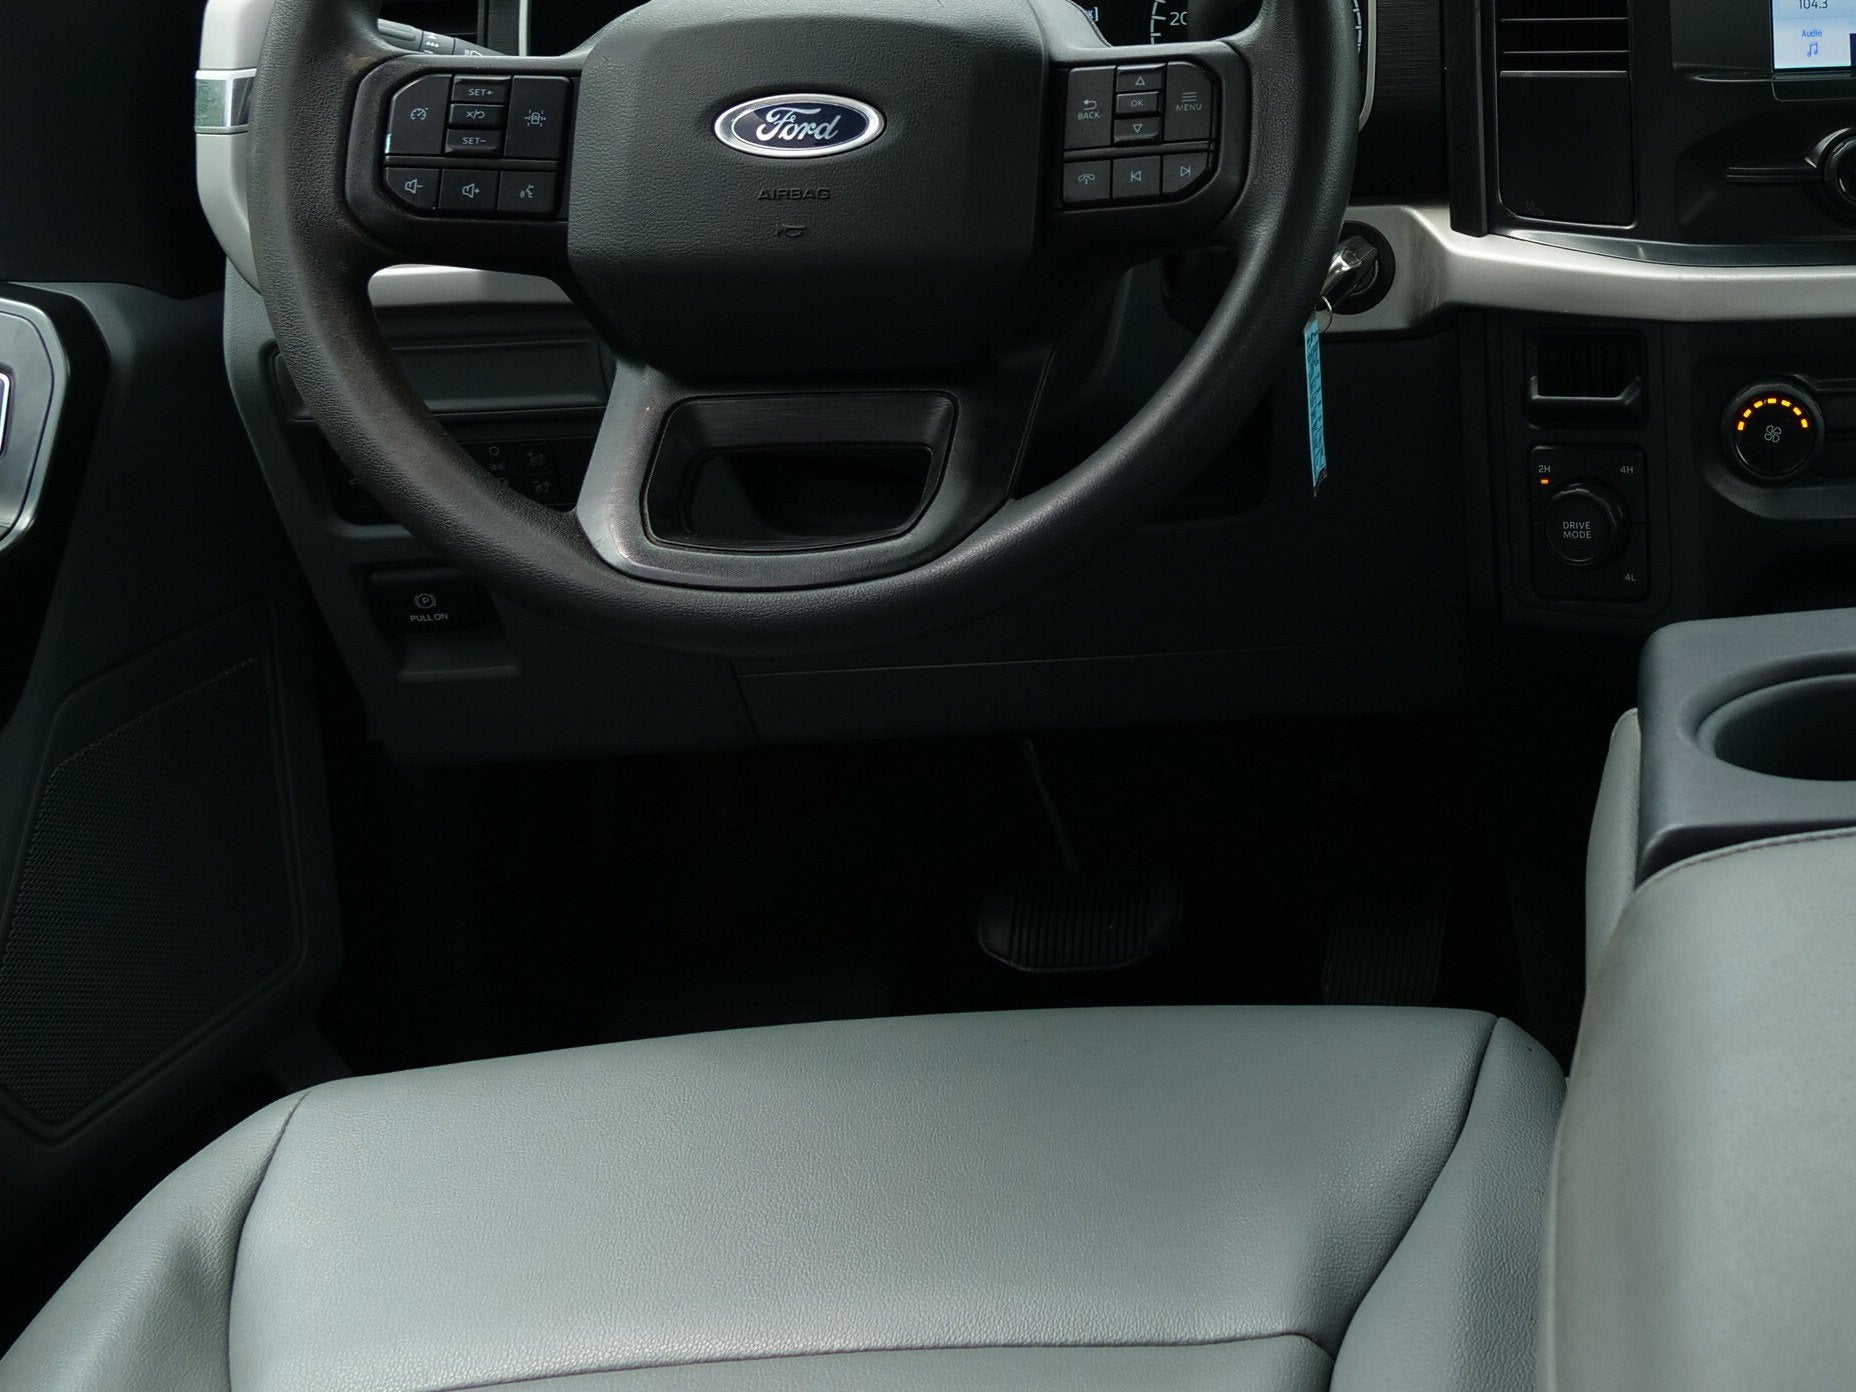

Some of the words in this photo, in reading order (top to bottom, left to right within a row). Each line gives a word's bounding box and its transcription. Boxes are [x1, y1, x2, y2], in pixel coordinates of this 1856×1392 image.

[1801, 29, 1823, 38] Audio
[468, 88, 493, 96] SET+
[1130, 99, 1143, 107] OK
[1175, 103, 1202, 112] MENU
[1077, 111, 1100, 120] BACK
[756, 107, 841, 141] Ford
[757, 187, 831, 201] AIRBAG
[1538, 464, 1551, 473] 2H
[1620, 465, 1634, 474] 4H
[1562, 521, 1591, 530] DRIVE
[1563, 530, 1592, 539] MODE
[1624, 573, 1637, 582] 4L
[410, 613, 433, 622] PULL
[433, 612, 449, 621] ON
